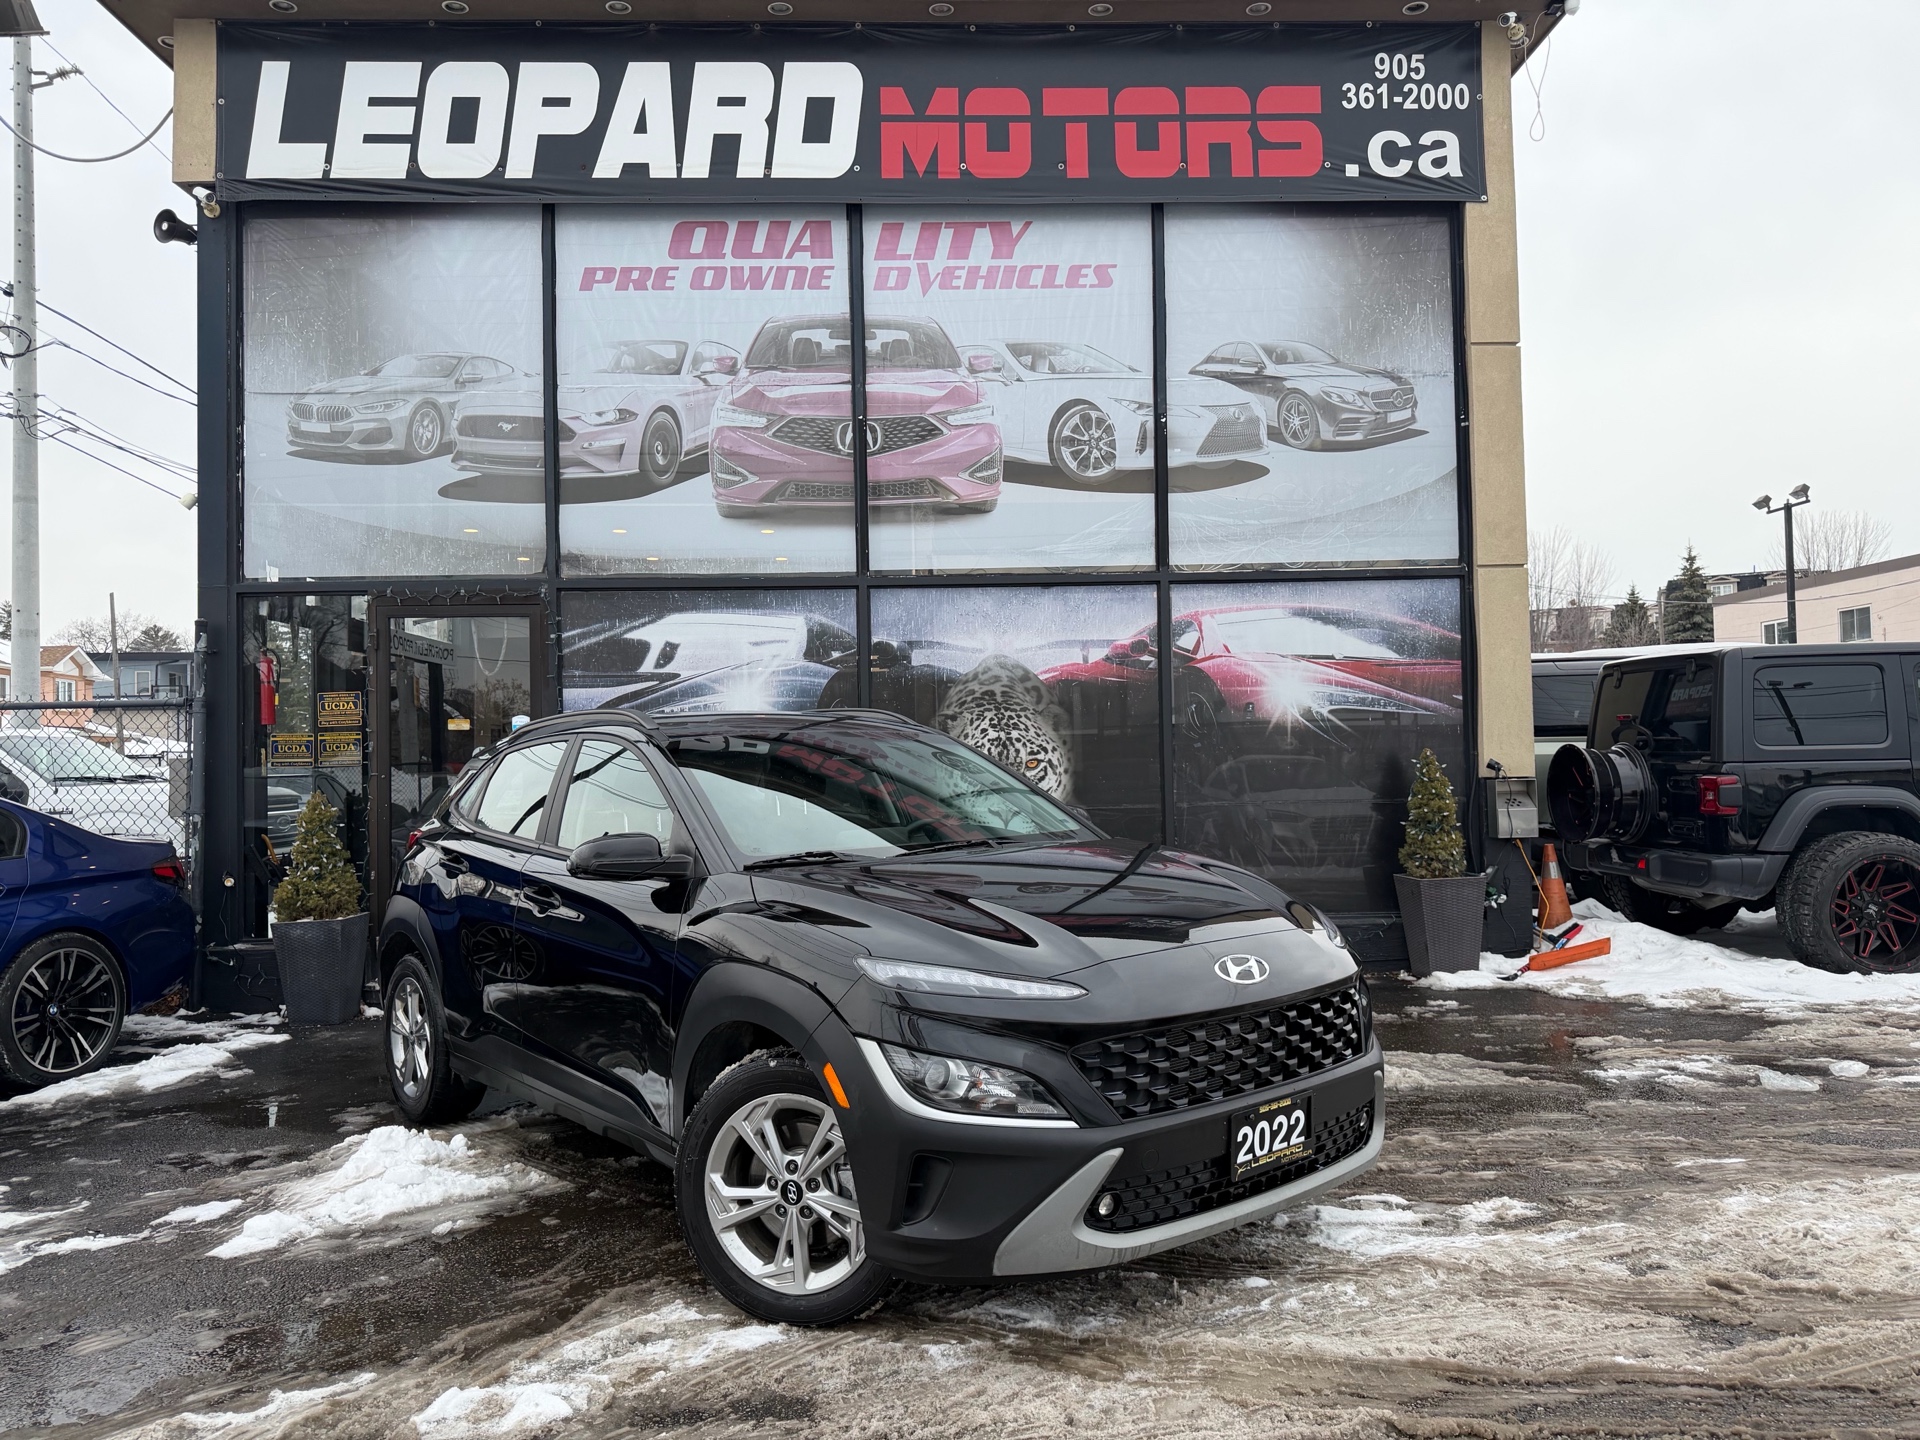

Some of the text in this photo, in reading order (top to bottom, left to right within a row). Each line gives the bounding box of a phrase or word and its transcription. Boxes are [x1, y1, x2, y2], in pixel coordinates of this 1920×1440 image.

[1374, 53, 1426, 81] 905
[1342, 83, 1470, 110] 361-2000
[246, 61, 1323, 179] LEOPARD MOTORS
[1345, 130, 1464, 178] .ca
[667, 220, 1033, 261] QUA LITY
[579, 266, 679, 291] PRE
[689, 265, 835, 291] OWNE
[324, 702, 355, 710] UCDA
[278, 745, 307, 753] UCDA
[326, 743, 355, 751] UCDA
[1236, 1109, 1305, 1164] 2022
[1251, 1143, 1303, 1168] LEOPARD
